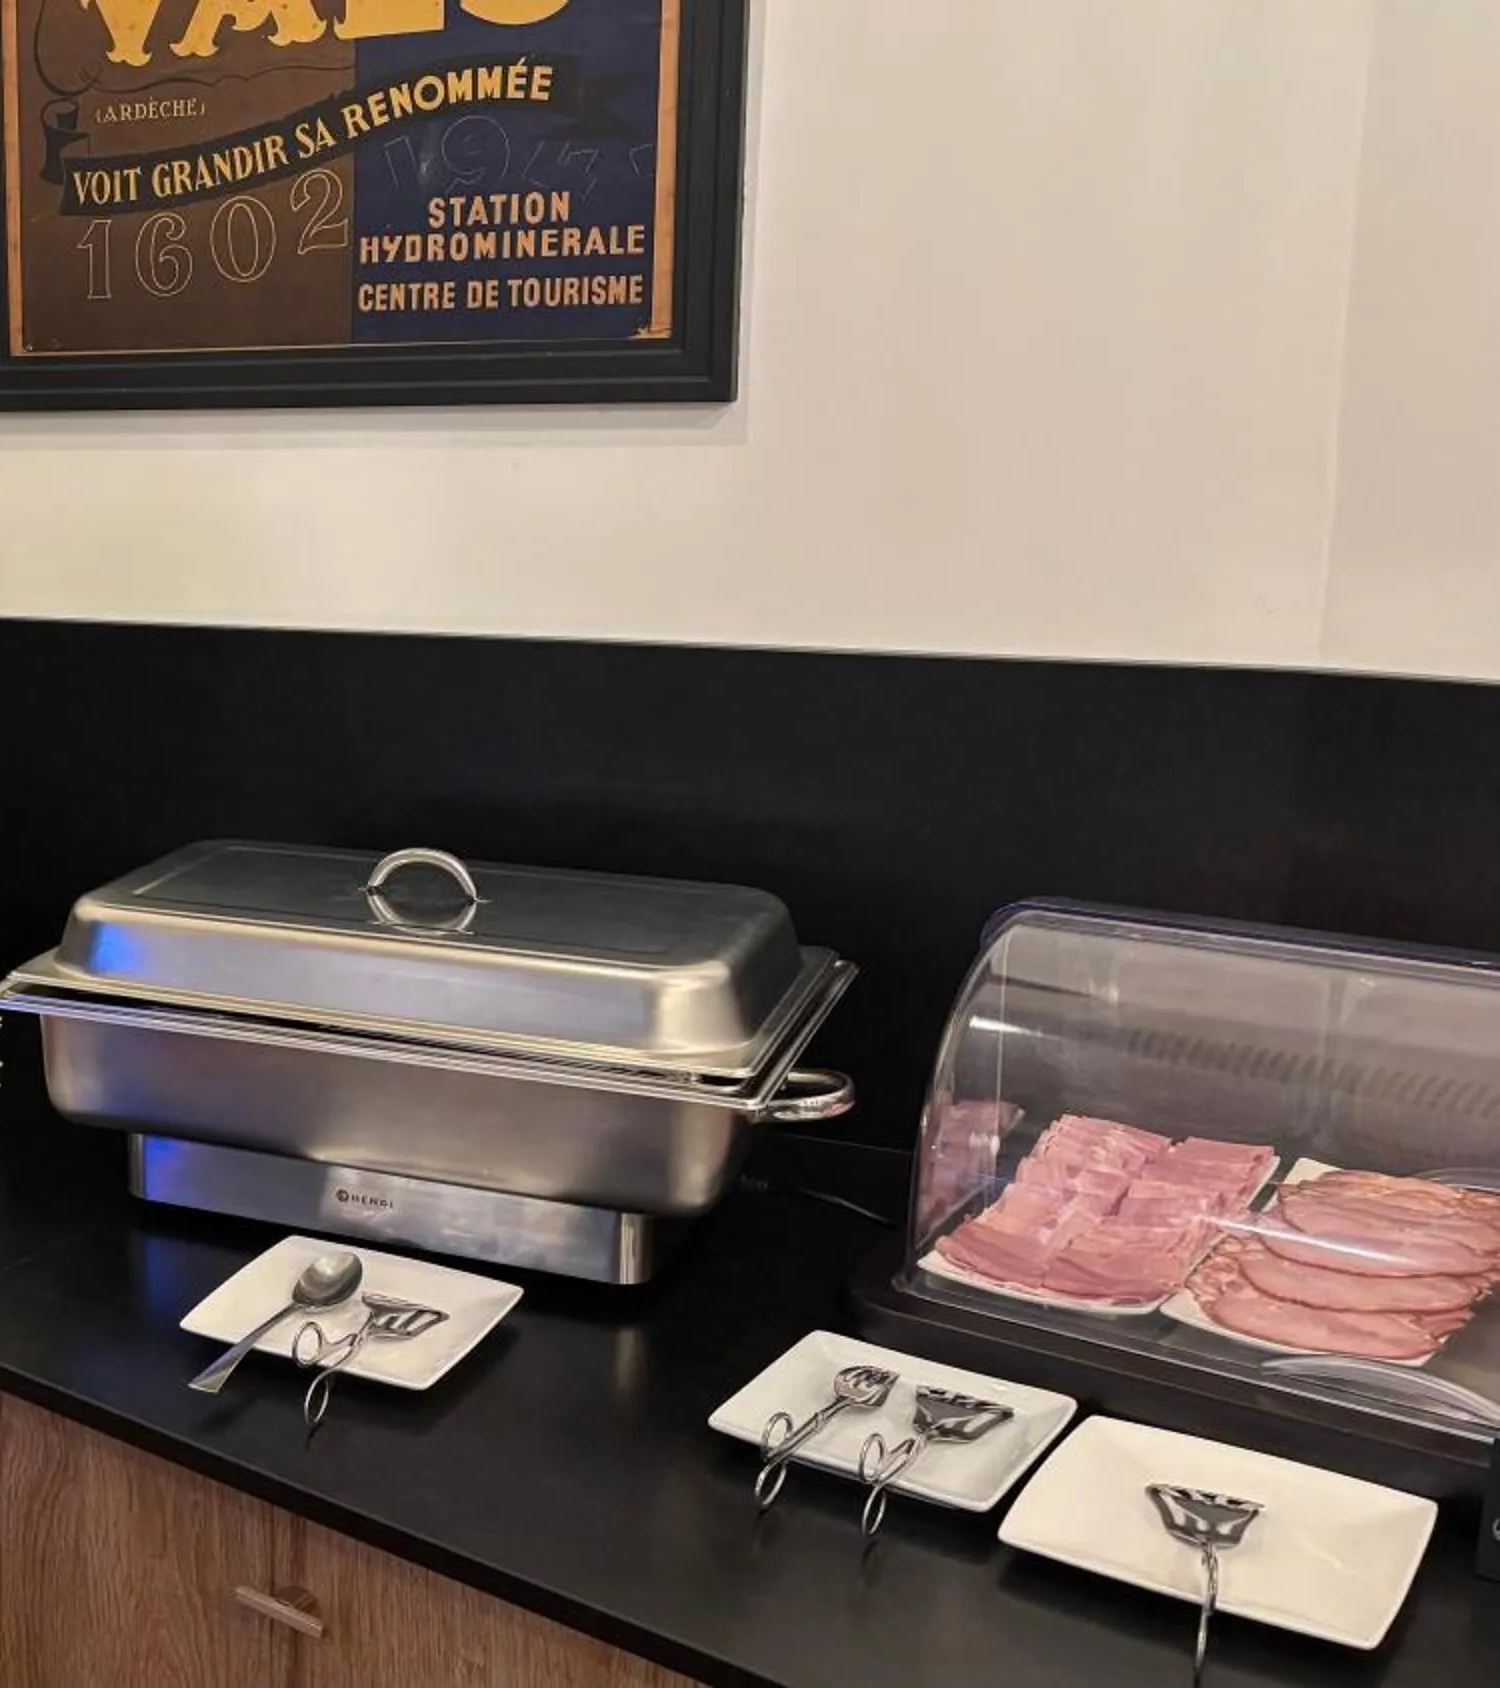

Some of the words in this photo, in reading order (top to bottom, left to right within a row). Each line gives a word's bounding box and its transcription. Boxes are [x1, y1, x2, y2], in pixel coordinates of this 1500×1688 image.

[73, 166, 143, 206] VOIT
[151, 135, 289, 198] GRANDIR
[294, 116, 338, 160] SA
[340, 56, 553, 140] RENOMMÉE
[428, 191, 571, 229] STATION
[76, 168, 349, 299] 1602
[359, 225, 645, 264] HYDROMINERALE
[358, 281, 456, 312] CENTRE
[466, 279, 499, 309] DE
[507, 275, 644, 307] TOURISME
